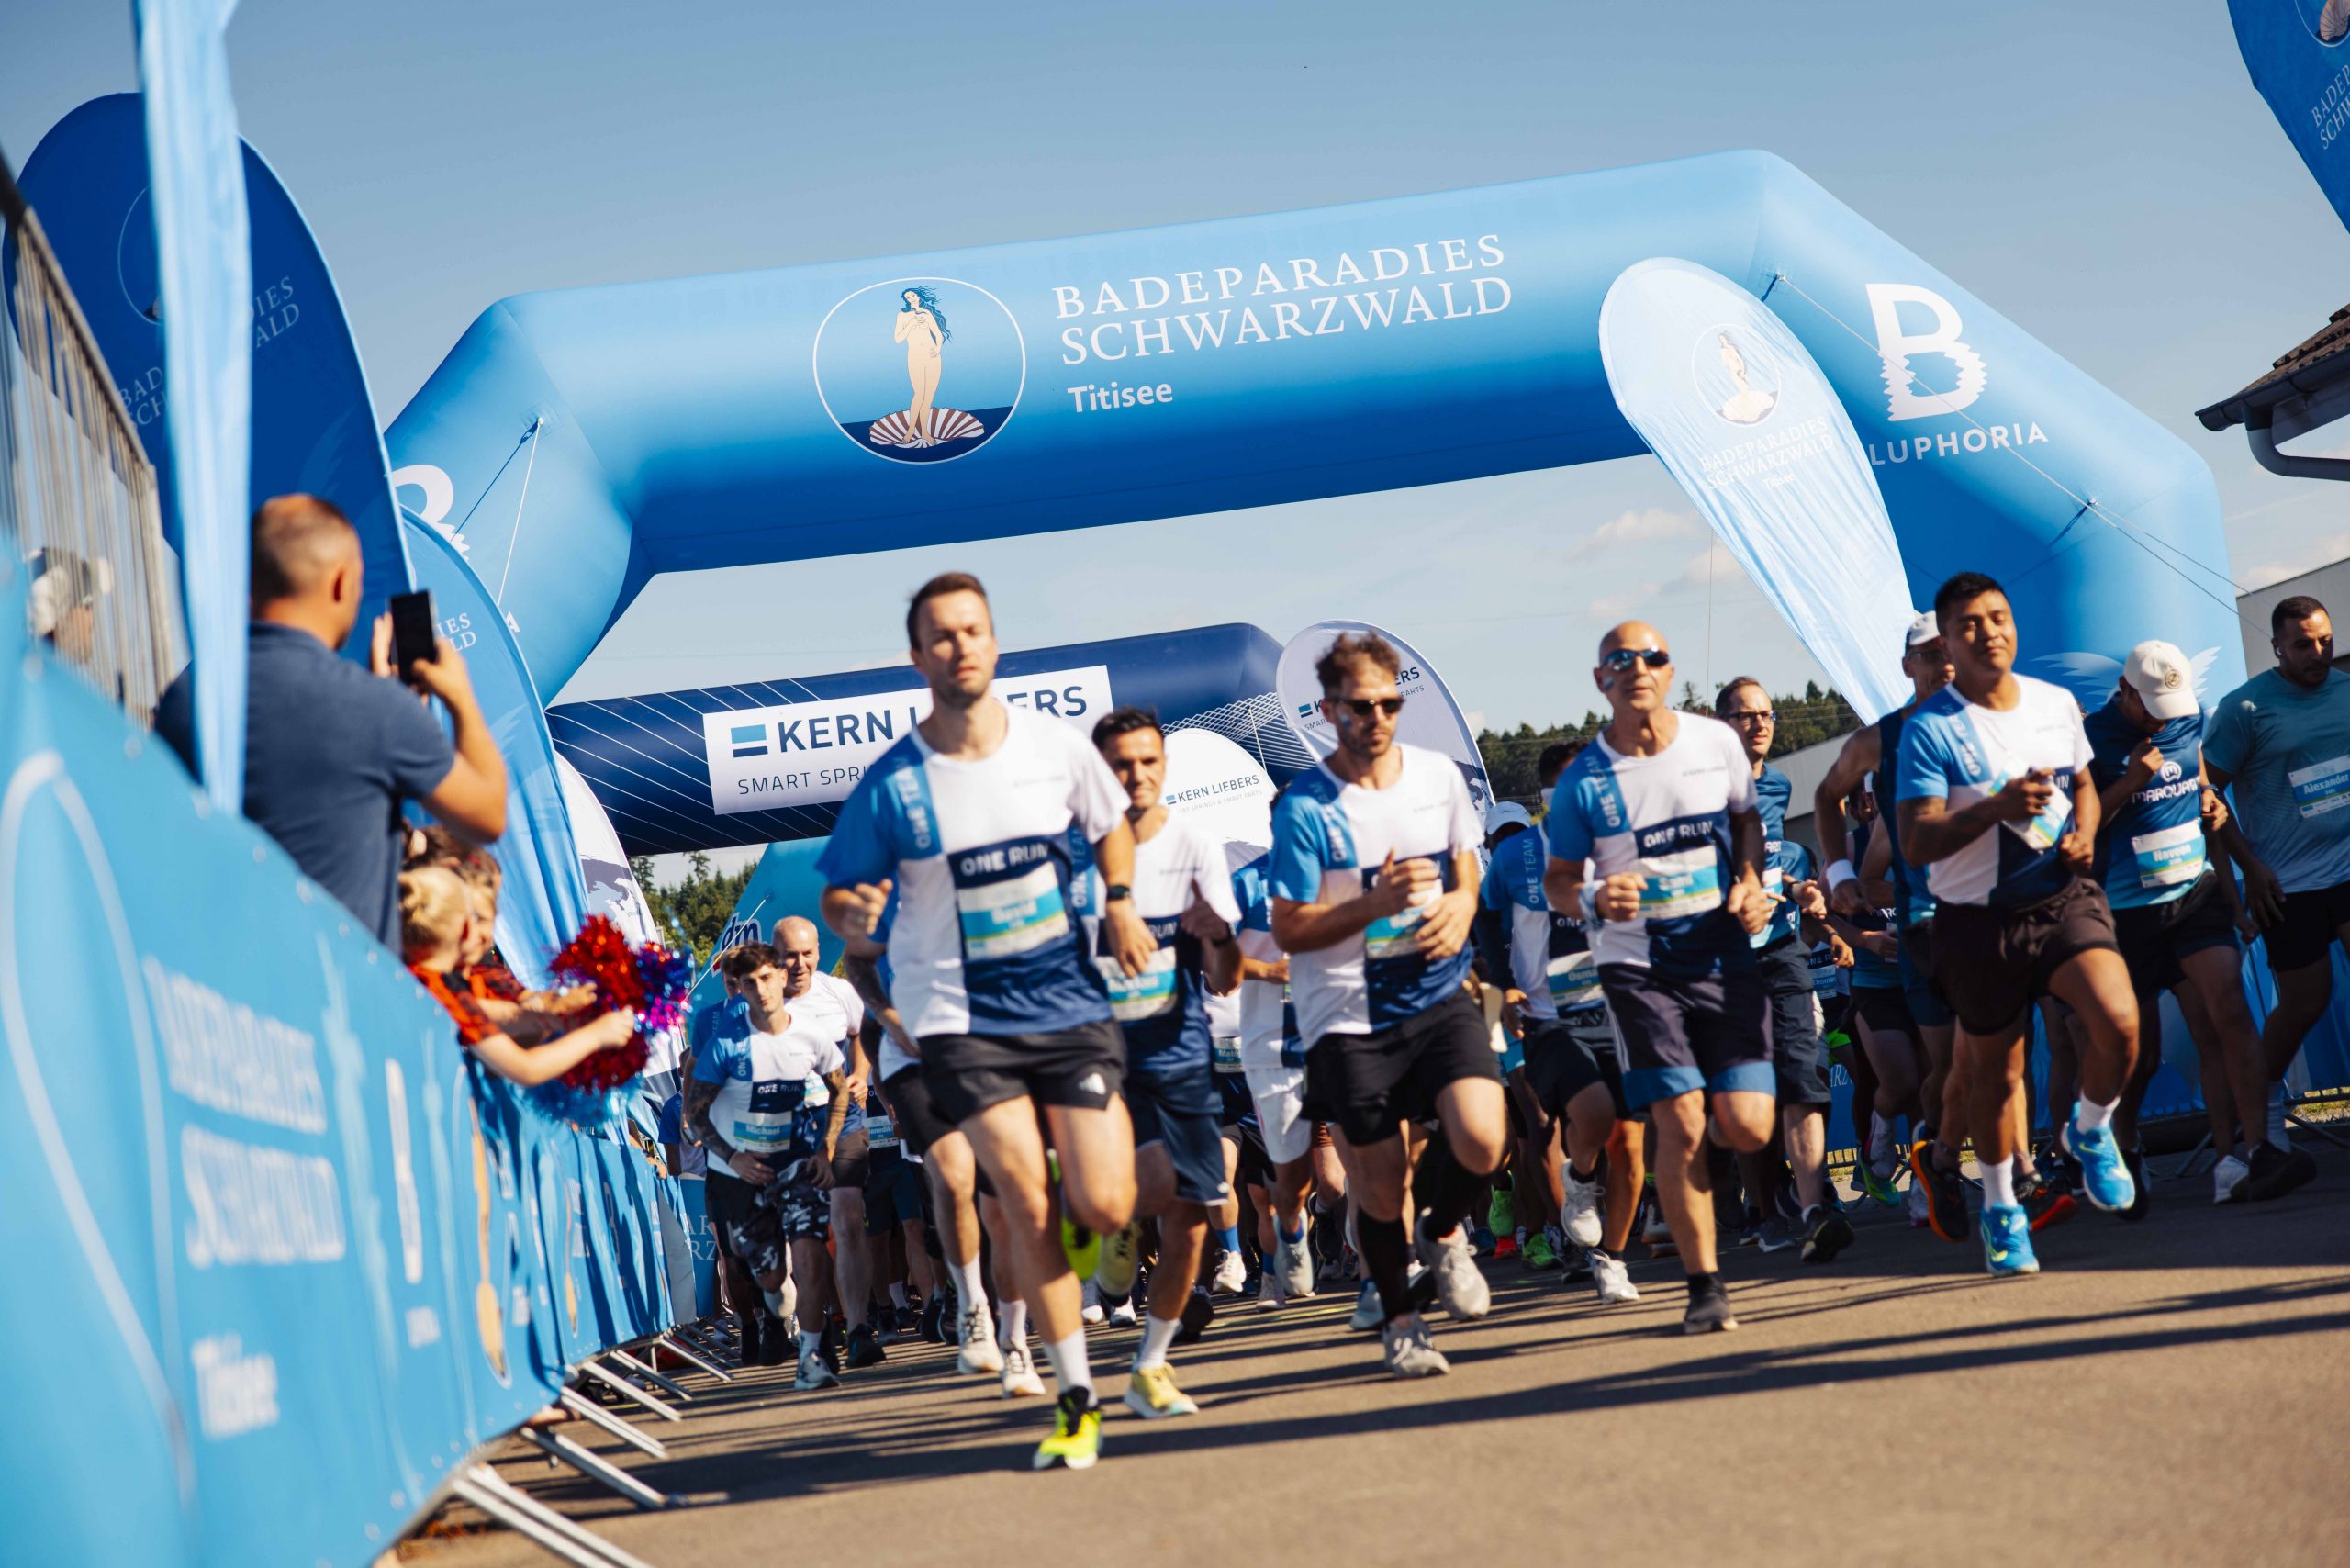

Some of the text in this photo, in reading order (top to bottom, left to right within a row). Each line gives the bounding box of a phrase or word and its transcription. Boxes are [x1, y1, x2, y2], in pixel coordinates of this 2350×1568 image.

[1052, 233, 1505, 319] BADEPARADIES
[1061, 276, 1512, 365] SCHWARZWALD
[1067, 380, 1174, 414] Titisee
[1698, 416, 1829, 472] BADEPARADIES
[1869, 421, 2049, 465] LUPHORIA
[1706, 434, 1833, 489] SCHWARZWALD
[778, 710, 894, 753] KERN
[1304, 719, 1327, 731] SMAR
[737, 772, 811, 796] SMART
[1178, 775, 1259, 802] KERN LIEBERS
[2303, 774, 2349, 795] Alexander
[1644, 828, 1675, 847] ONE
[961, 843, 1050, 876] ONE RUN
[1523, 838, 1539, 904] ONE TEAM
[758, 1084, 778, 1093] ONE
